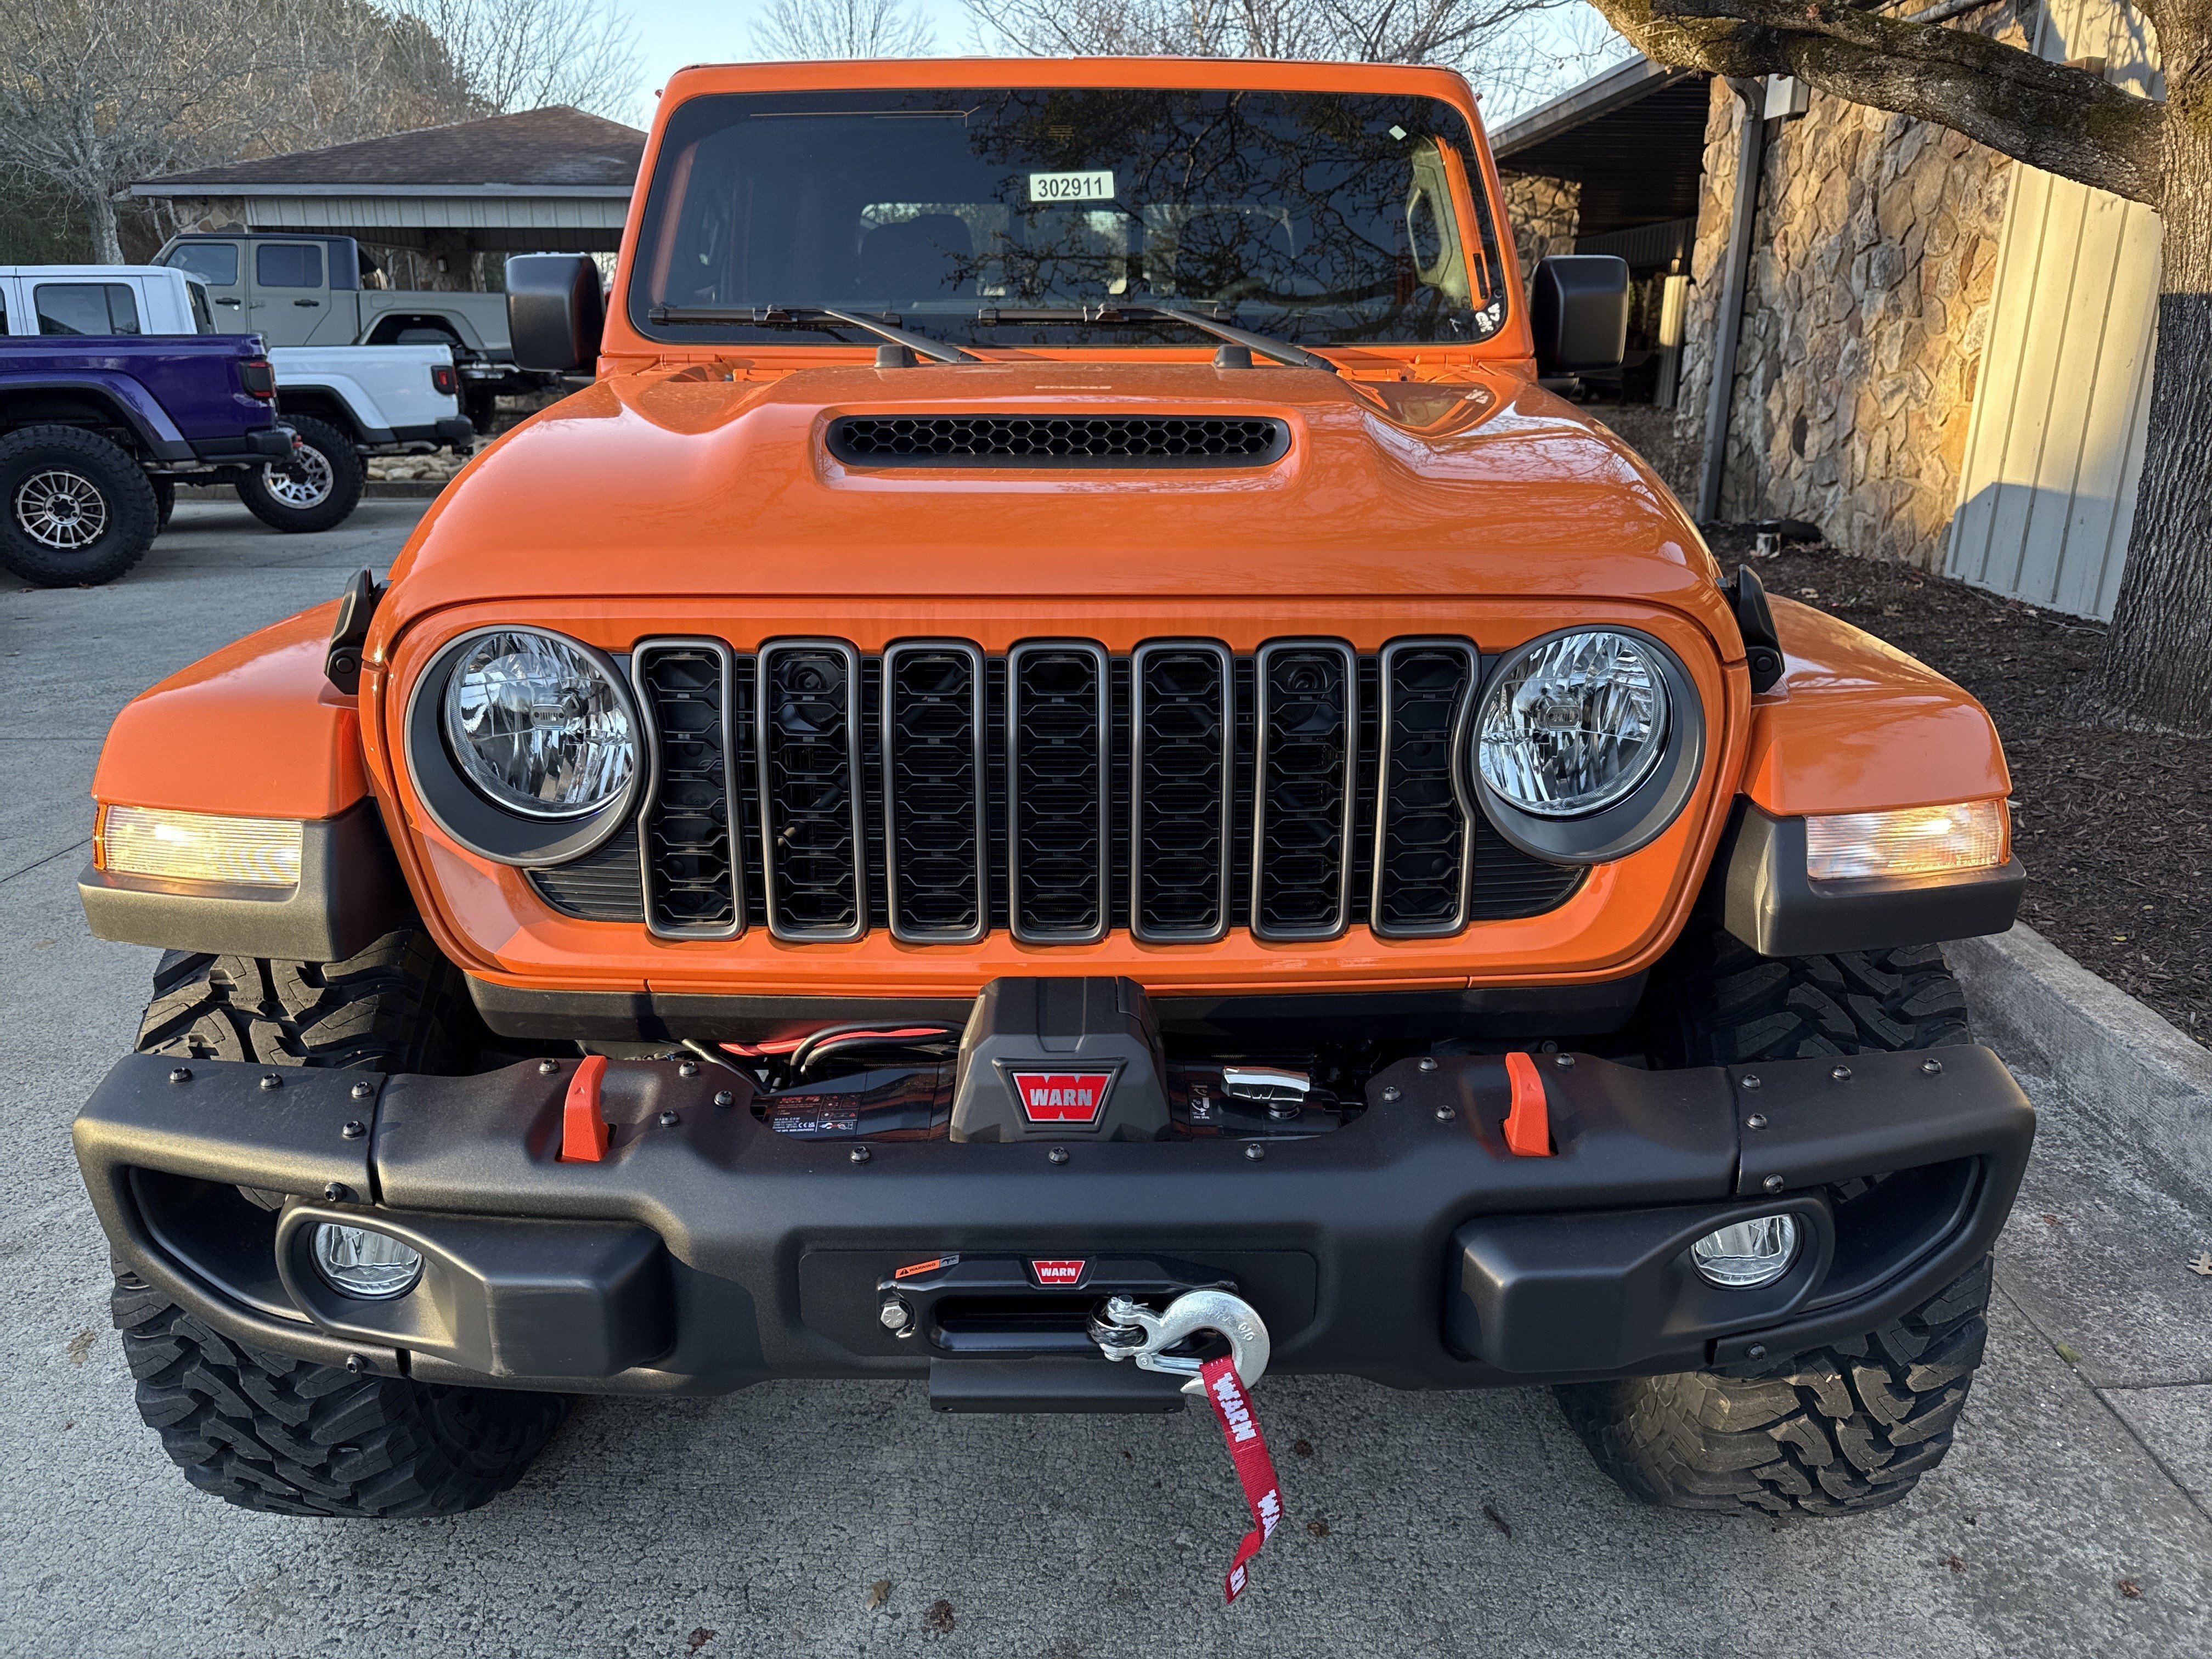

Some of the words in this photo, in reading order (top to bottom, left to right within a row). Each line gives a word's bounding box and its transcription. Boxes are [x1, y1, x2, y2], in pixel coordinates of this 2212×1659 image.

[1039, 177, 1102, 198] 302911
[1029, 1088, 1092, 1107] WARN
[909, 1262, 936, 1273] WARNING
[1041, 1267, 1076, 1277] WARN
[1212, 1372, 1257, 1443] WARN
[1257, 1488, 1280, 1543] WA
